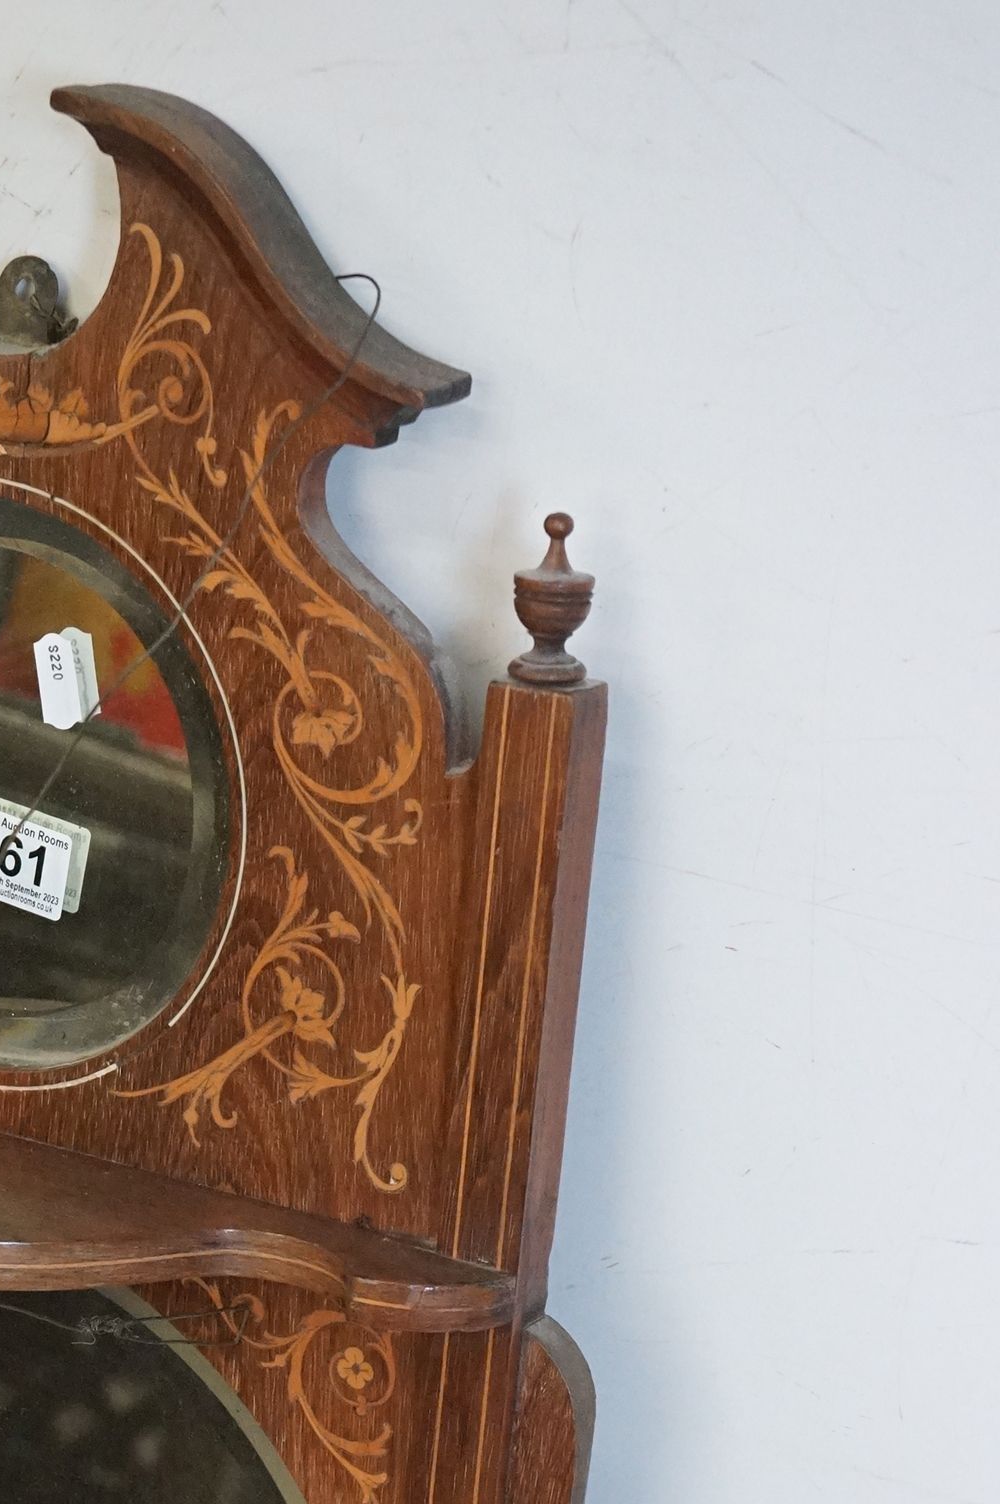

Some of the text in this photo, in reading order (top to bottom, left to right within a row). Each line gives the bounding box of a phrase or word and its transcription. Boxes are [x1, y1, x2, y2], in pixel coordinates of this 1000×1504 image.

[47, 645, 64, 681] S220
[1, 817, 36, 839] Auction
[37, 830, 69, 850] Rooms
[5, 879, 42, 900] September
[43, 892, 60, 906] 2023
